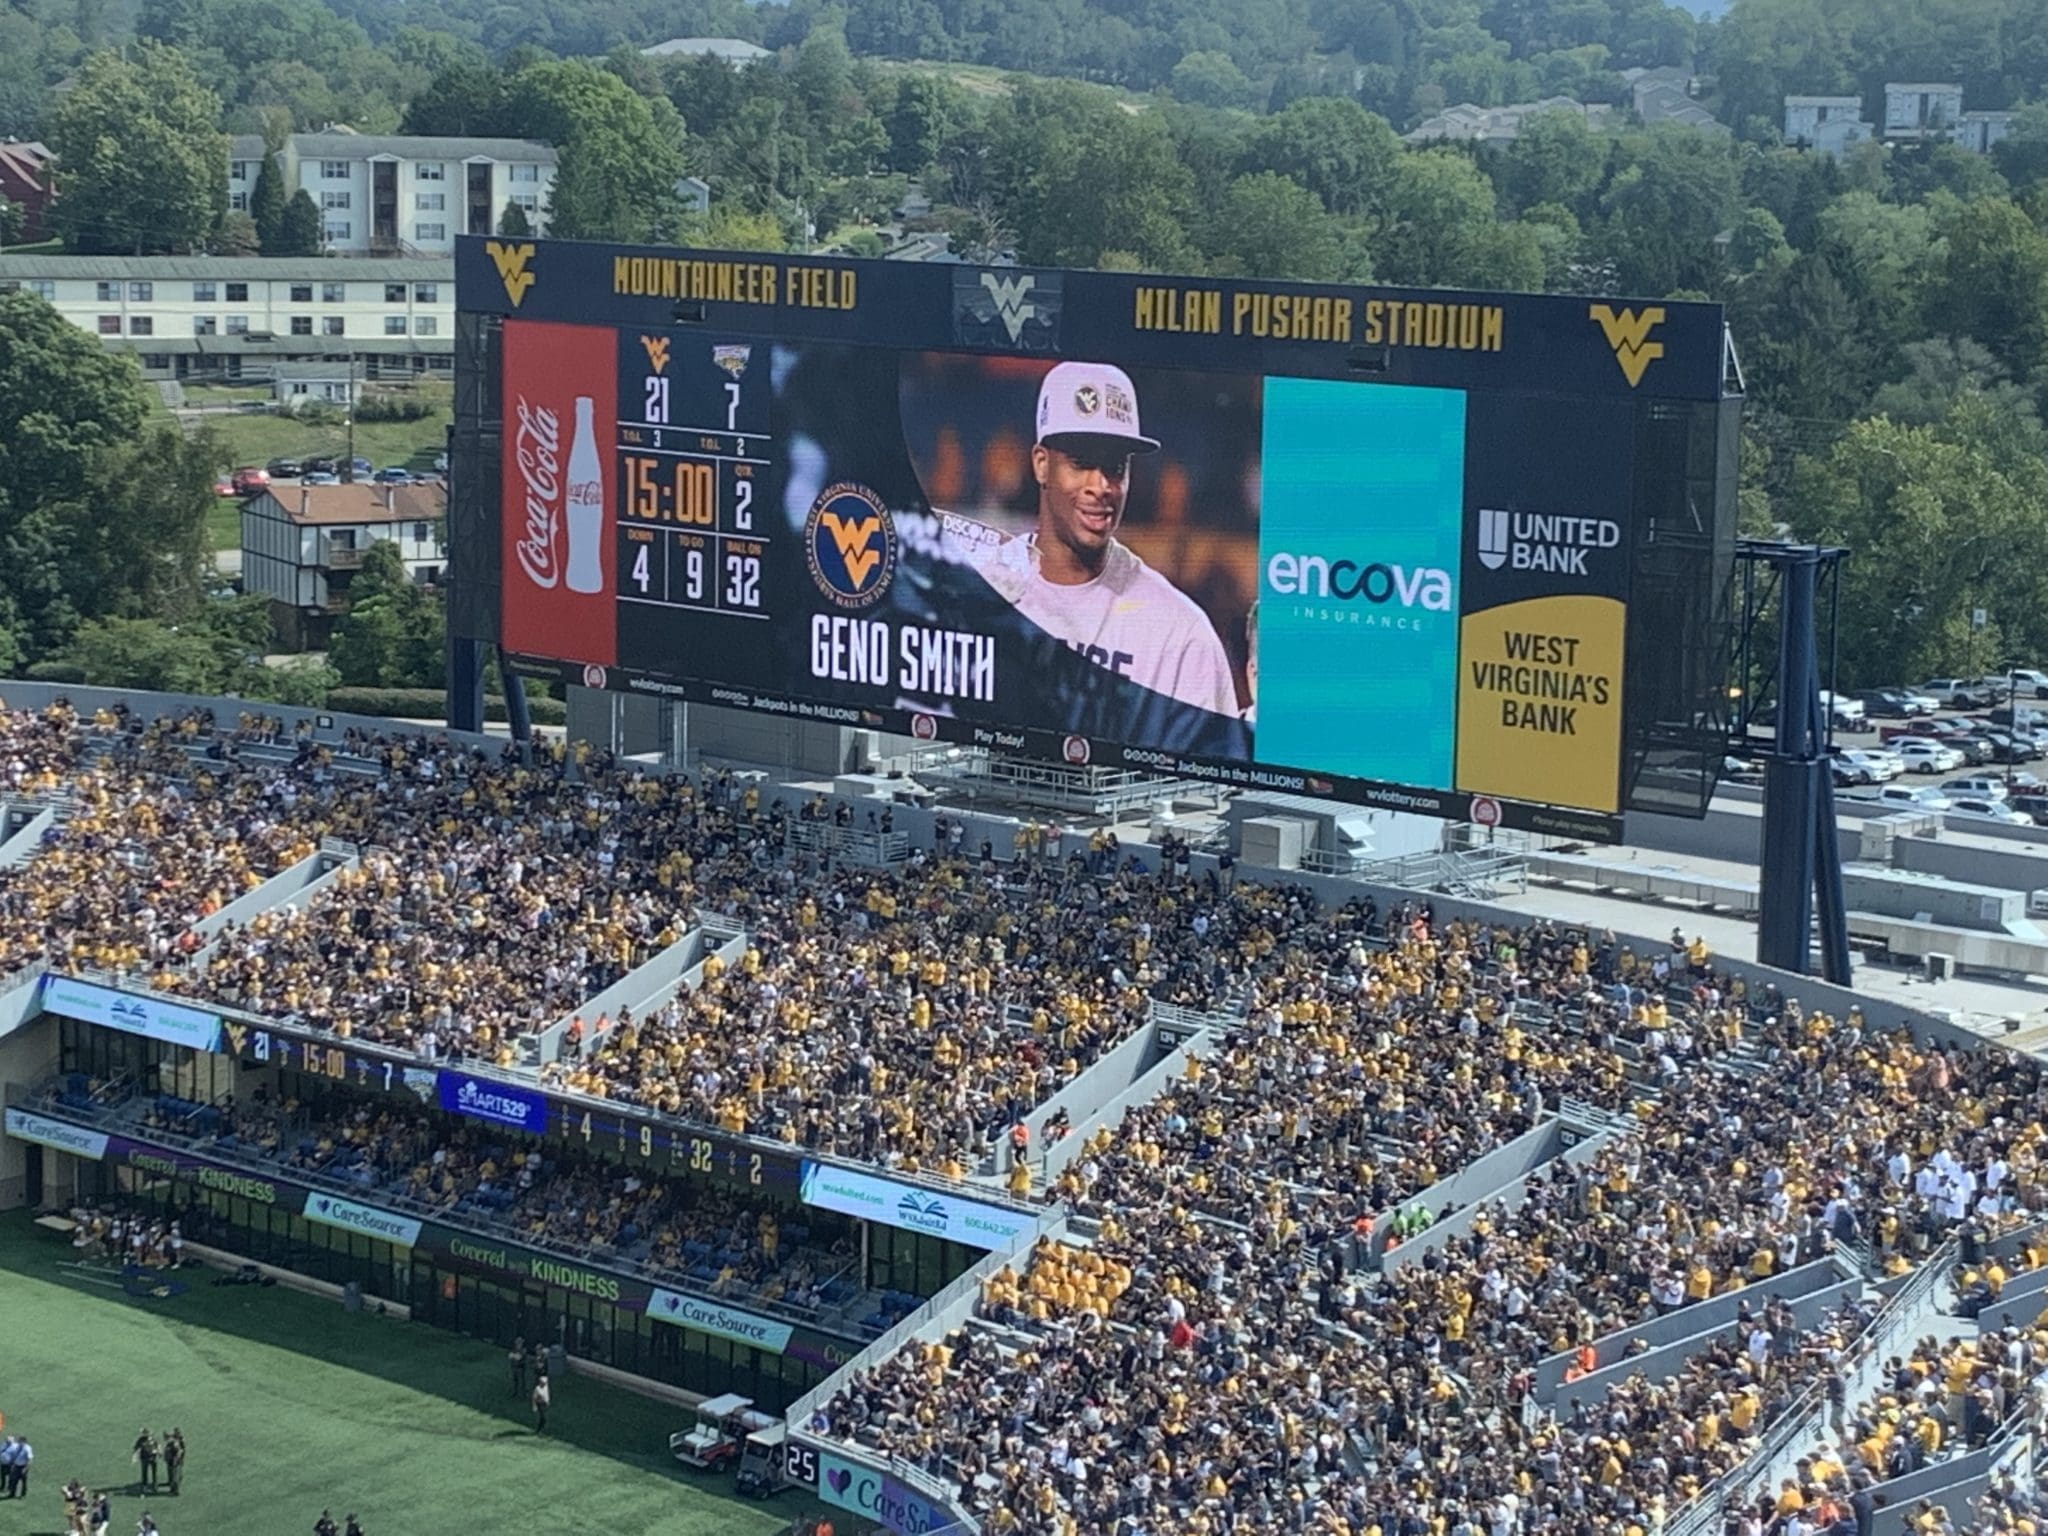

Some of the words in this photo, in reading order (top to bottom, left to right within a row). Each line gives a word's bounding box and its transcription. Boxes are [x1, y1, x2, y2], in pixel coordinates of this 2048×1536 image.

[614, 256, 776, 305] MOUNTAINEER
[787, 267, 857, 310] FIELD
[1135, 287, 1221, 334] MILAN
[1232, 292, 1351, 343] PUSKAR
[1365, 300, 1504, 351] STADIUM
[645, 376, 669, 423] 21
[724, 383, 740, 430] 7
[653, 430, 661, 447] 3
[737, 438, 745, 456] 2
[625, 457, 713, 525] 15:00
[735, 480, 752, 530] 2
[1513, 512, 1620, 548] UNITED
[632, 544, 650, 592] 4
[687, 550, 703, 599] 9
[1511, 542, 1588, 576] BANK
[727, 555, 760, 607] 32
[1268, 552, 1451, 612] encova
[1294, 606, 1421, 631] INSURANCE
[812, 613, 889, 686] GENO
[900, 625, 995, 701] SMITH
[1504, 631, 1580, 667] WEST
[1472, 661, 1610, 705] VIRGINIA'S
[1502, 699, 1577, 735] BANK
[974, 728, 994, 744] Play
[995, 732, 1024, 749] Today!
[1177, 760, 1219, 778] Jackpots
[1220, 765, 1230, 778] in
[1232, 768, 1248, 782] the
[1366, 789, 1440, 809] wvlottery.com
[254, 1031, 269, 1061] 21
[303, 1042, 345, 1080] 15:00
[382, 1061, 393, 1091] 7
[580, 1111, 592, 1142] 4
[640, 1126, 651, 1157] 9
[690, 1138, 713, 1172] 32
[750, 1153, 762, 1185] 2
[198, 1166, 276, 1204] KINDNESS
[332, 1203, 407, 1237] CareSource
[450, 1238, 506, 1268] Covered
[531, 1258, 620, 1301] KINDNESS
[682, 1301, 766, 1340] CareSource
[788, 1446, 814, 1481] 25
